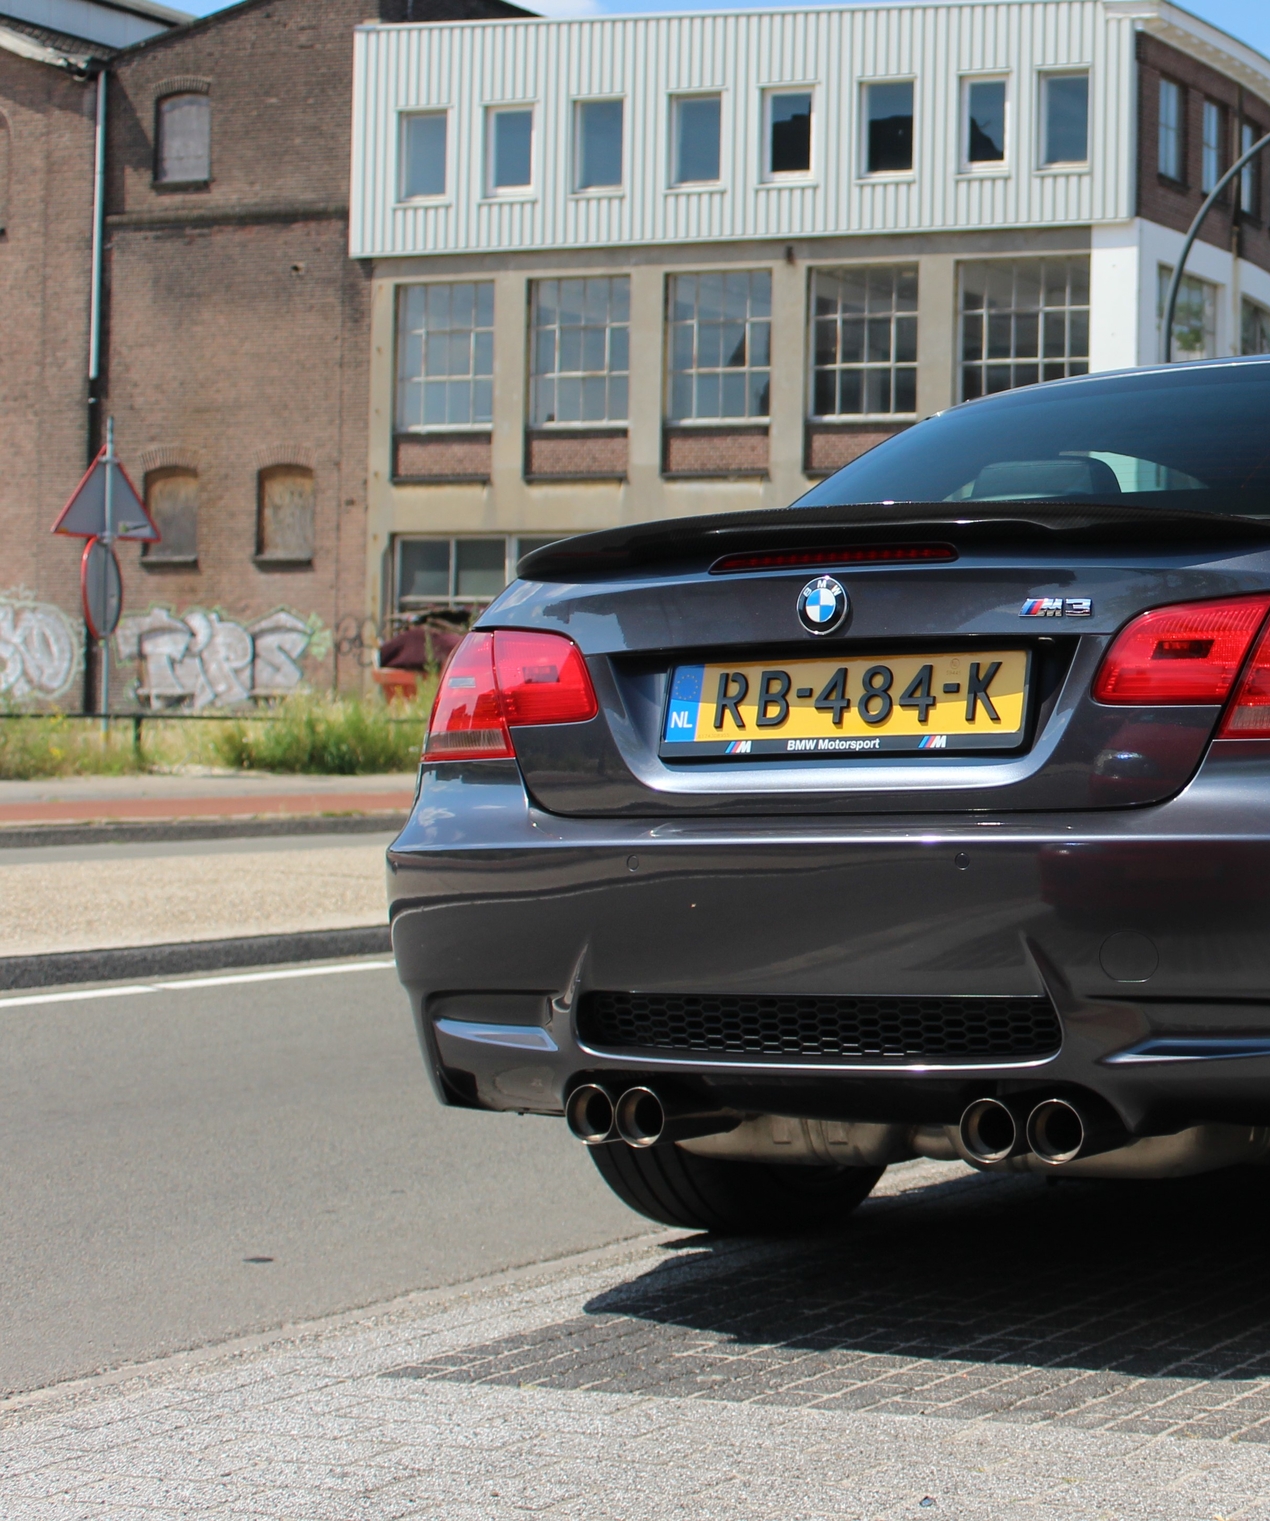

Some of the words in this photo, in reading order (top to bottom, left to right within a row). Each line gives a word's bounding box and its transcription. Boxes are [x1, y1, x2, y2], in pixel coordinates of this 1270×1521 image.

[803, 580, 842, 597] BMW
[713, 661, 1002, 728] RB-484-K
[671, 711, 693, 728] NL
[787, 740, 816, 750] BMW
[818, 738, 880, 751] Motorsport
